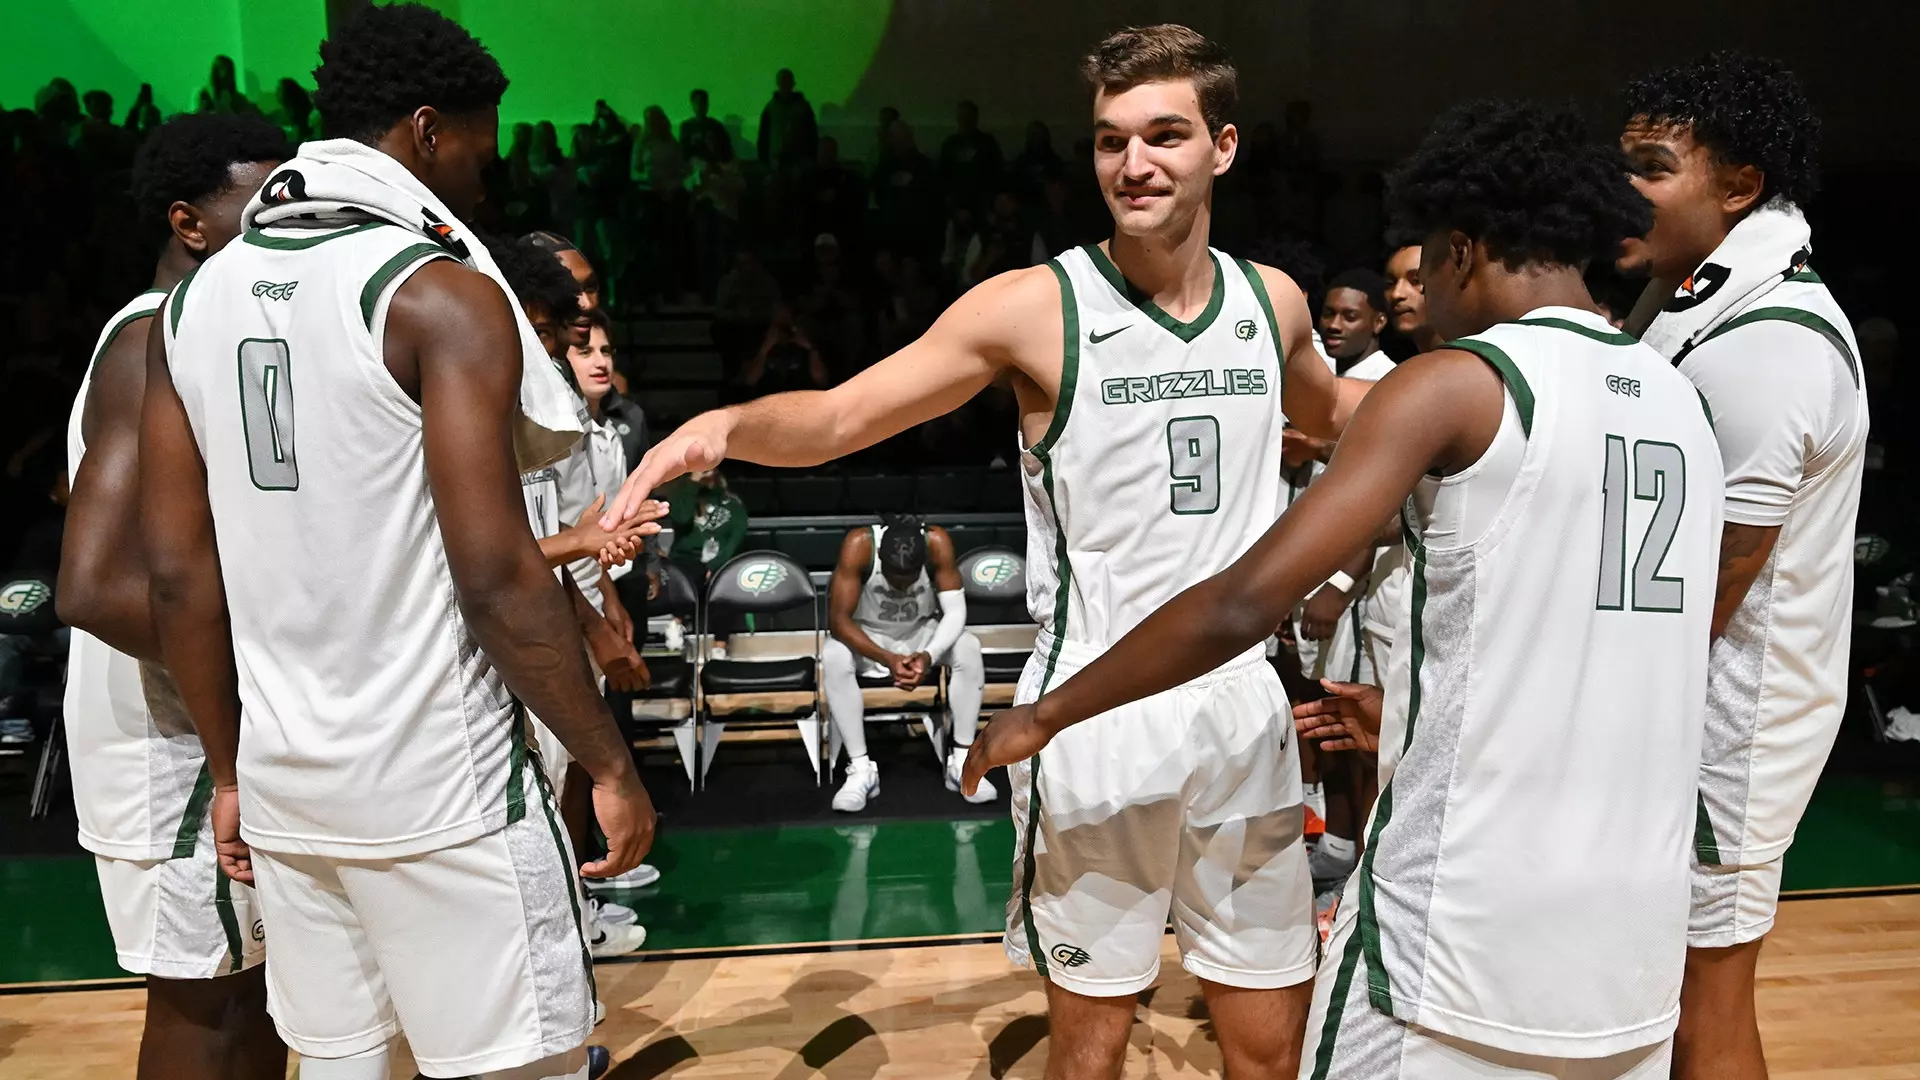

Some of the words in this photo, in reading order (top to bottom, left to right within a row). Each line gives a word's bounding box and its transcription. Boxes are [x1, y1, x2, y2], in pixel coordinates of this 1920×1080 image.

[252, 281, 298, 301] GGC
[237, 337, 299, 491] 0
[1101, 369, 1268, 405] GRIZZLIES
[1605, 374, 1641, 398] GGC
[1167, 415, 1220, 515] 9
[1596, 433, 1686, 613] 12
